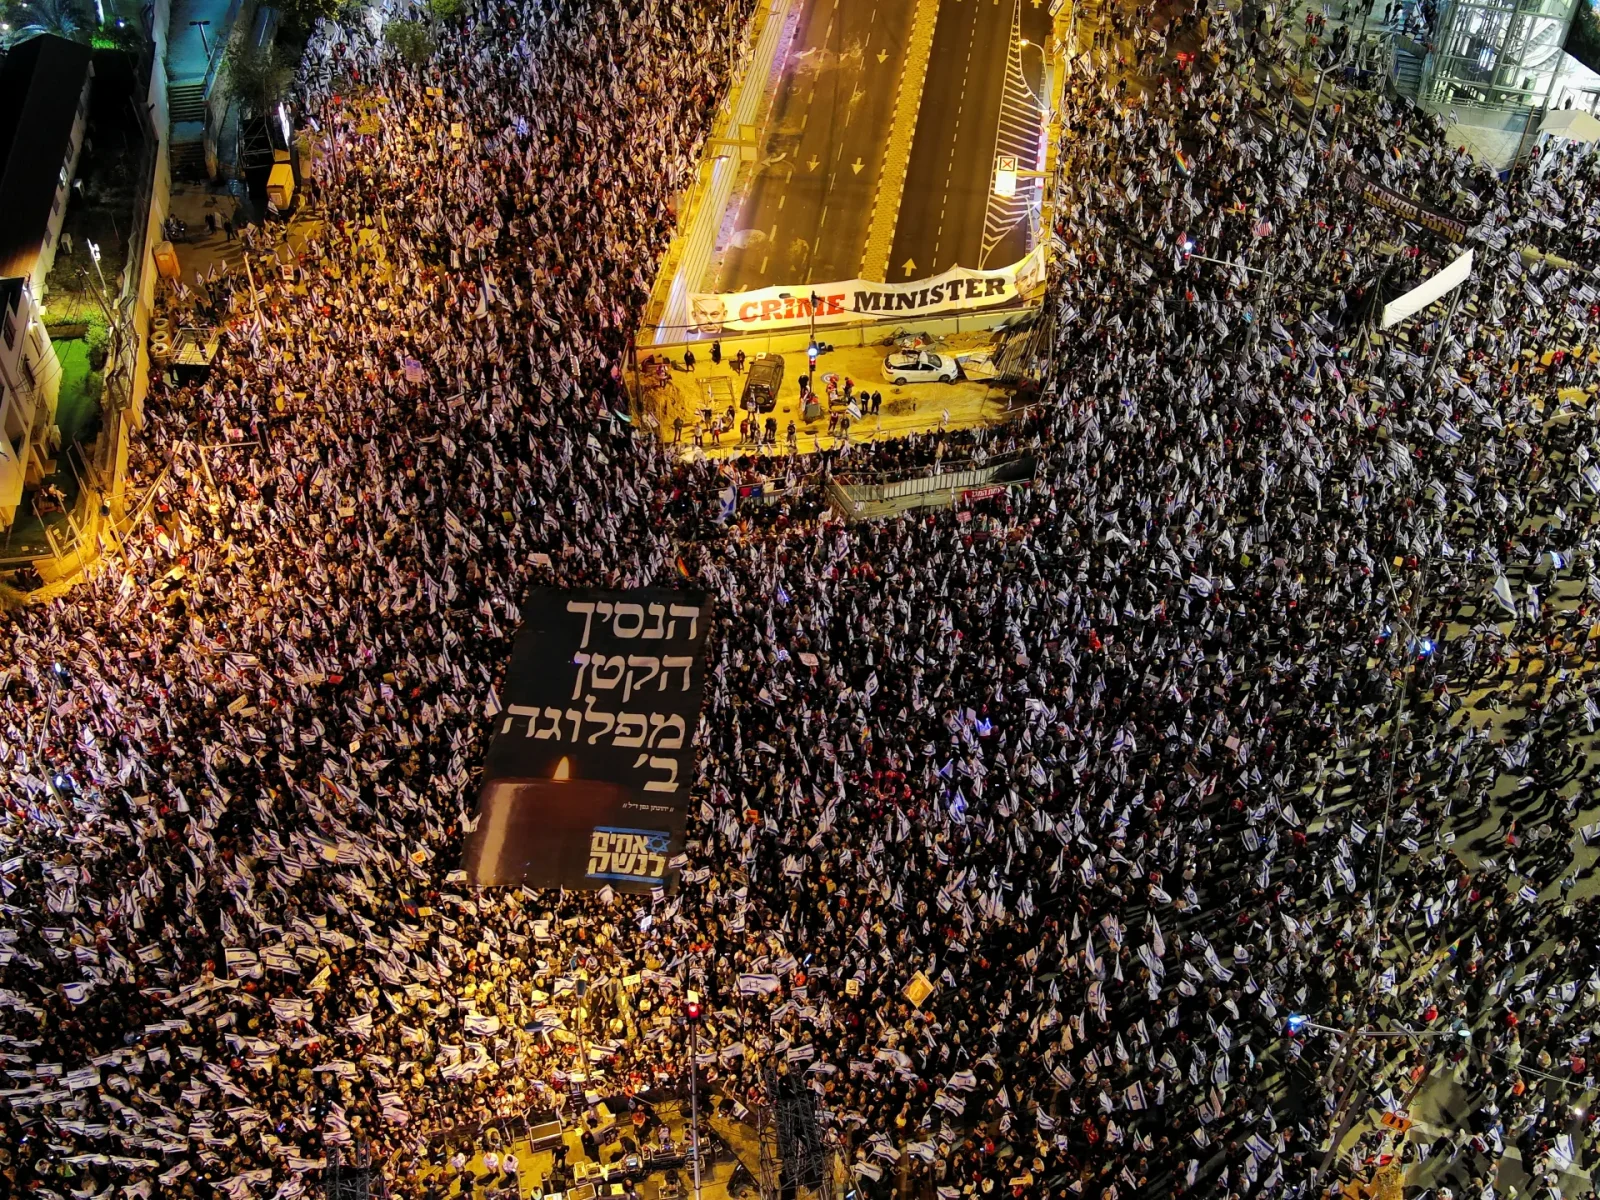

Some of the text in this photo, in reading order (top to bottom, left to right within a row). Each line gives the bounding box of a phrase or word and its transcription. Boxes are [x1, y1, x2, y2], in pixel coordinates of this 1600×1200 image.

[739, 277, 1006, 322] CRIME MINISTER
[566, 600, 700, 649] הנסיך
[571, 650, 694, 703] הקטן
[500, 694, 686, 750] מפלוגה
[587, 851, 666, 877] לנשק
[590, 831, 649, 854] אחים
